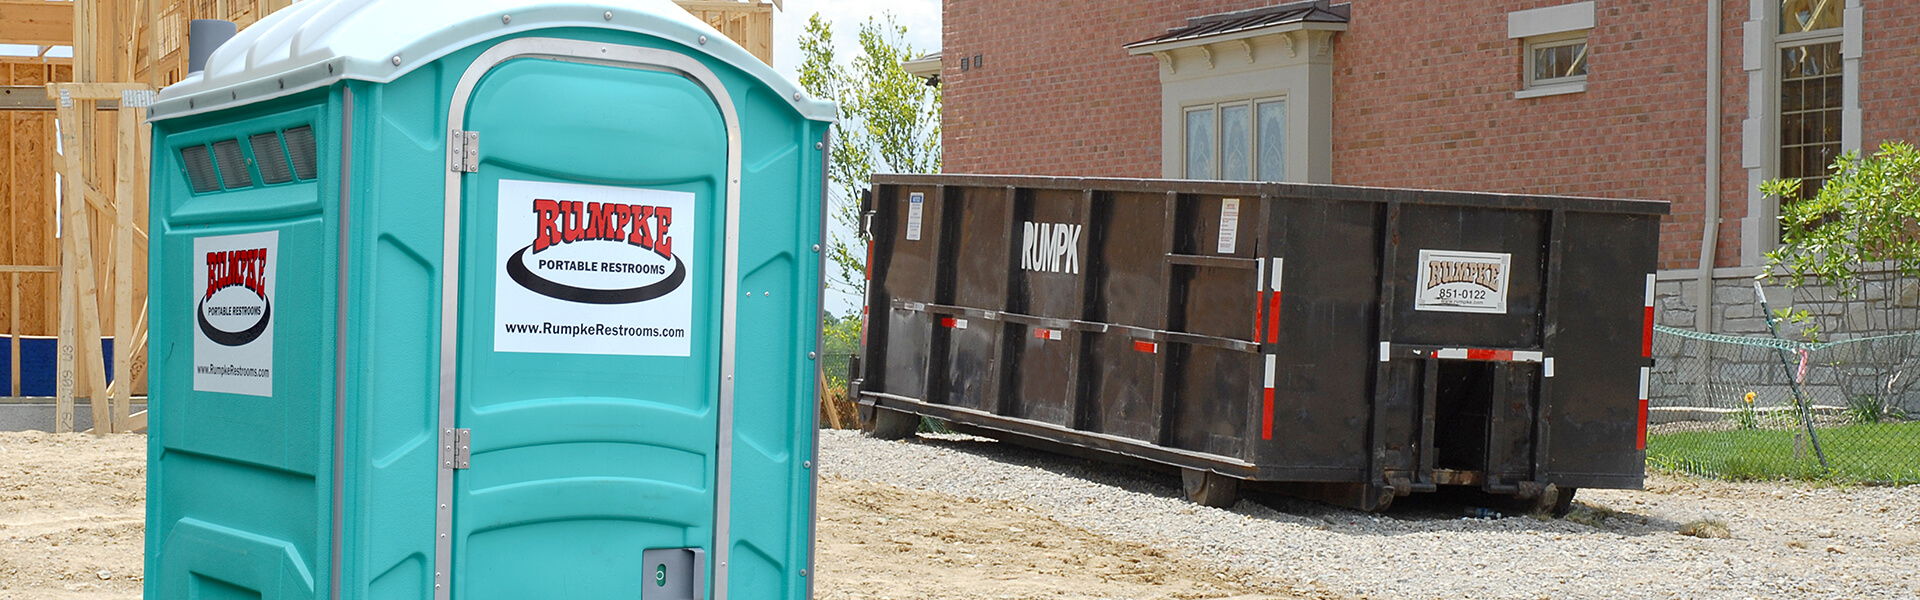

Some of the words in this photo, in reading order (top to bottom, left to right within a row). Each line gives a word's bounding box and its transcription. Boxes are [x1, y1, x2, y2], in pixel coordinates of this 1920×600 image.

[533, 199, 672, 261] RUMPKE
[1021, 221, 1081, 274] RUMPK
[538, 259, 598, 272] PORTABLE
[600, 262, 666, 275] RESTROOMS
[206, 248, 267, 303] RUMPKE
[1427, 260, 1501, 292] RUMPKE
[1439, 288, 1486, 300] 851-0122
[208, 306, 232, 316] PORTABLE
[233, 306, 261, 316] RESTROOMS
[505, 322, 685, 338] www.RumpkeRestrooms.com
[197, 363, 270, 378] www.RumpkeRestrooms.com
